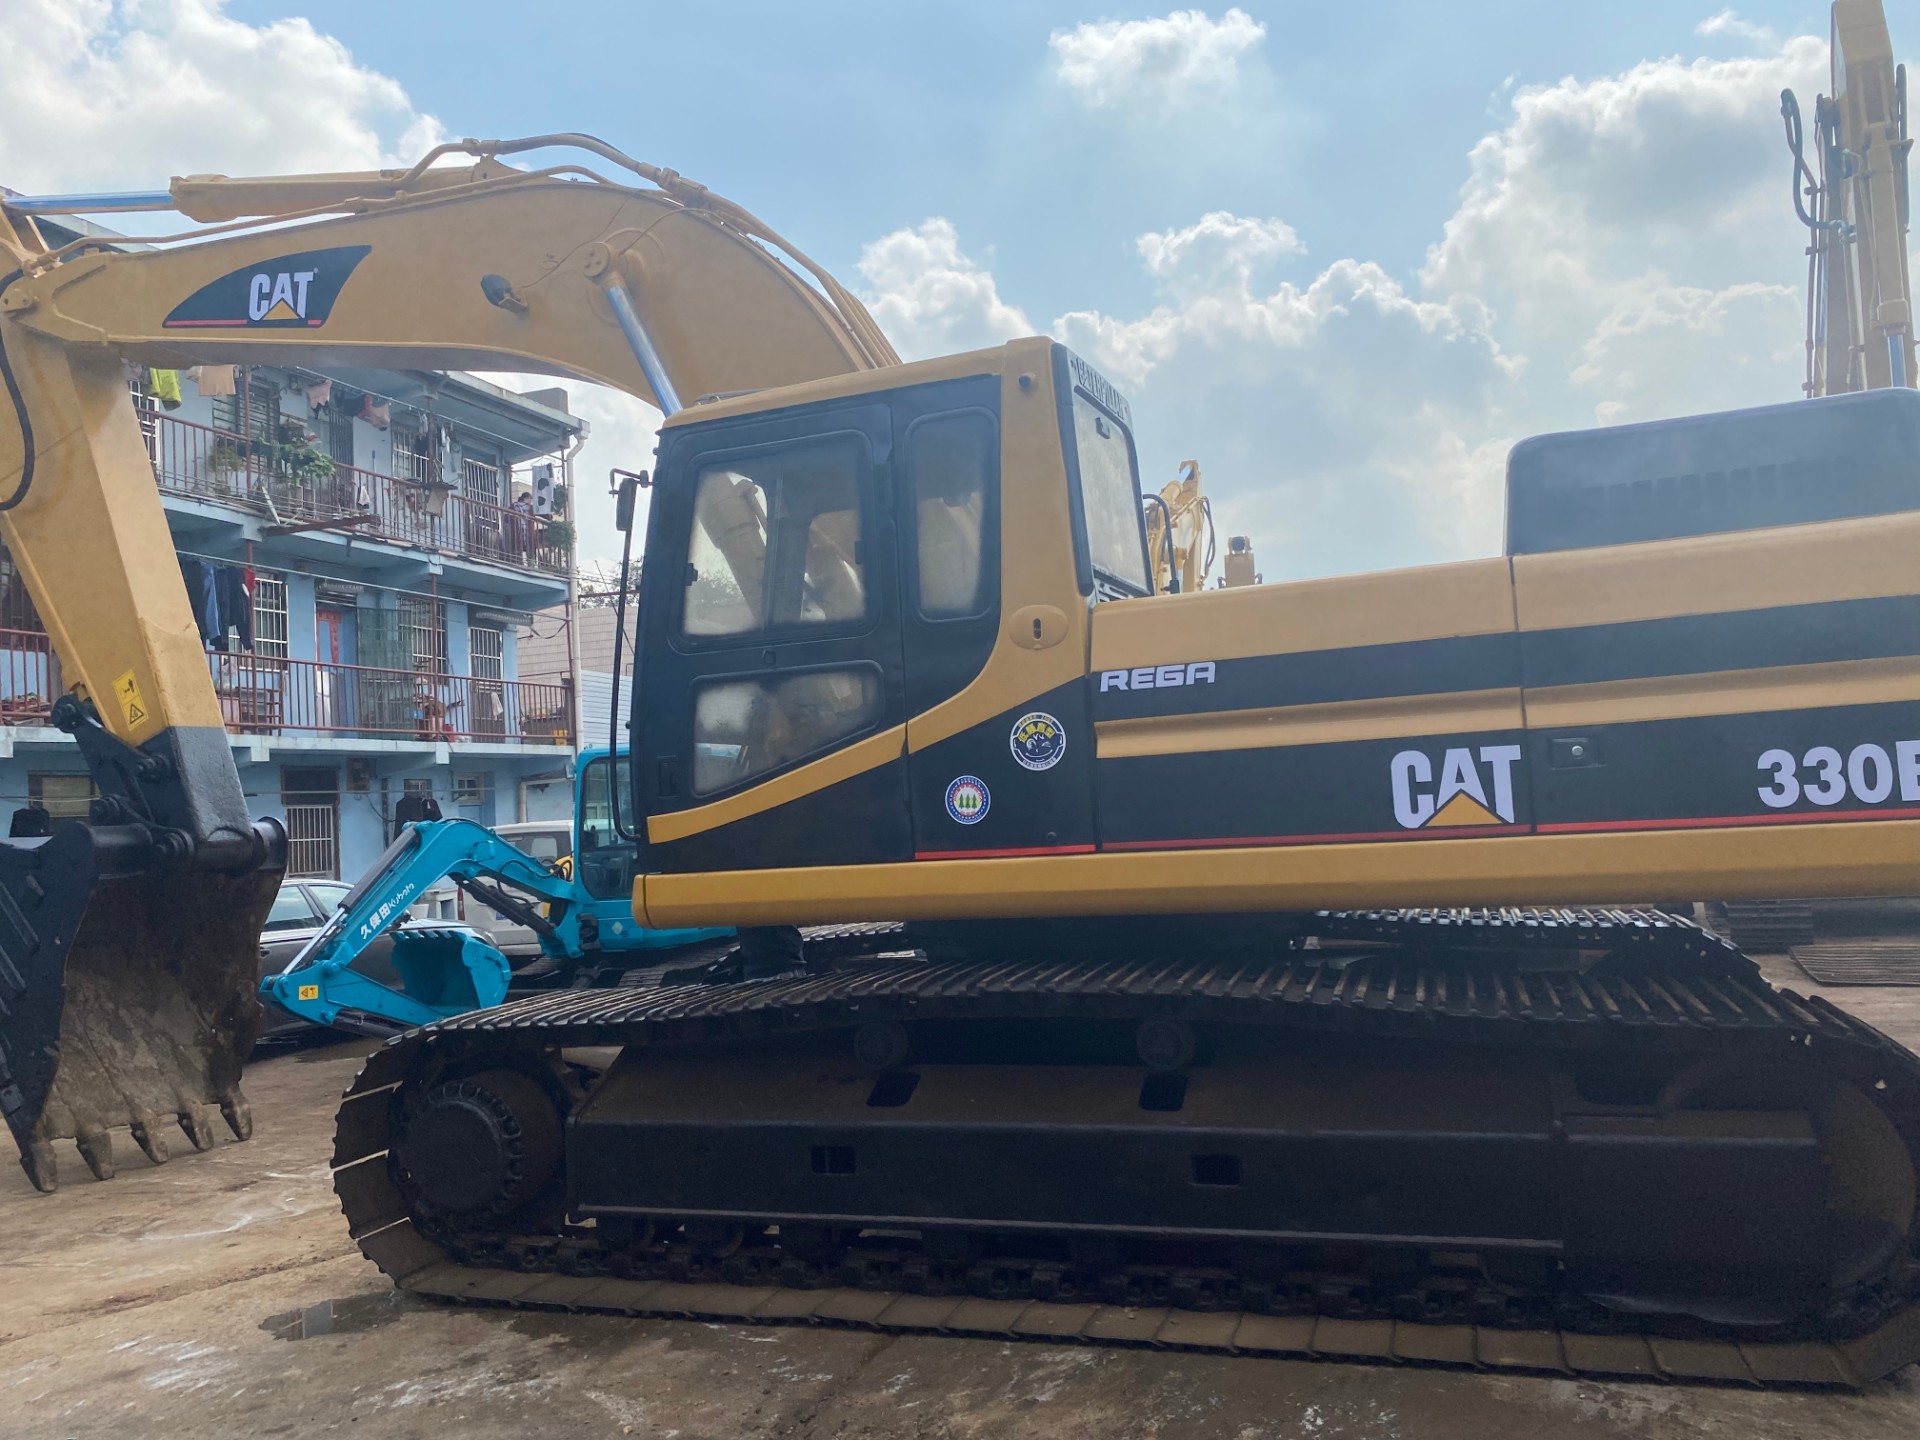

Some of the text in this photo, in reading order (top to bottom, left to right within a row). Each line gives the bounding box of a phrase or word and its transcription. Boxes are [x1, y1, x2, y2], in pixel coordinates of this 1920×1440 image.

[249, 271, 314, 320] CAT
[1100, 661, 1216, 692] REGA
[1390, 744, 1522, 829] CAT
[360, 902, 391, 940] 久保田
